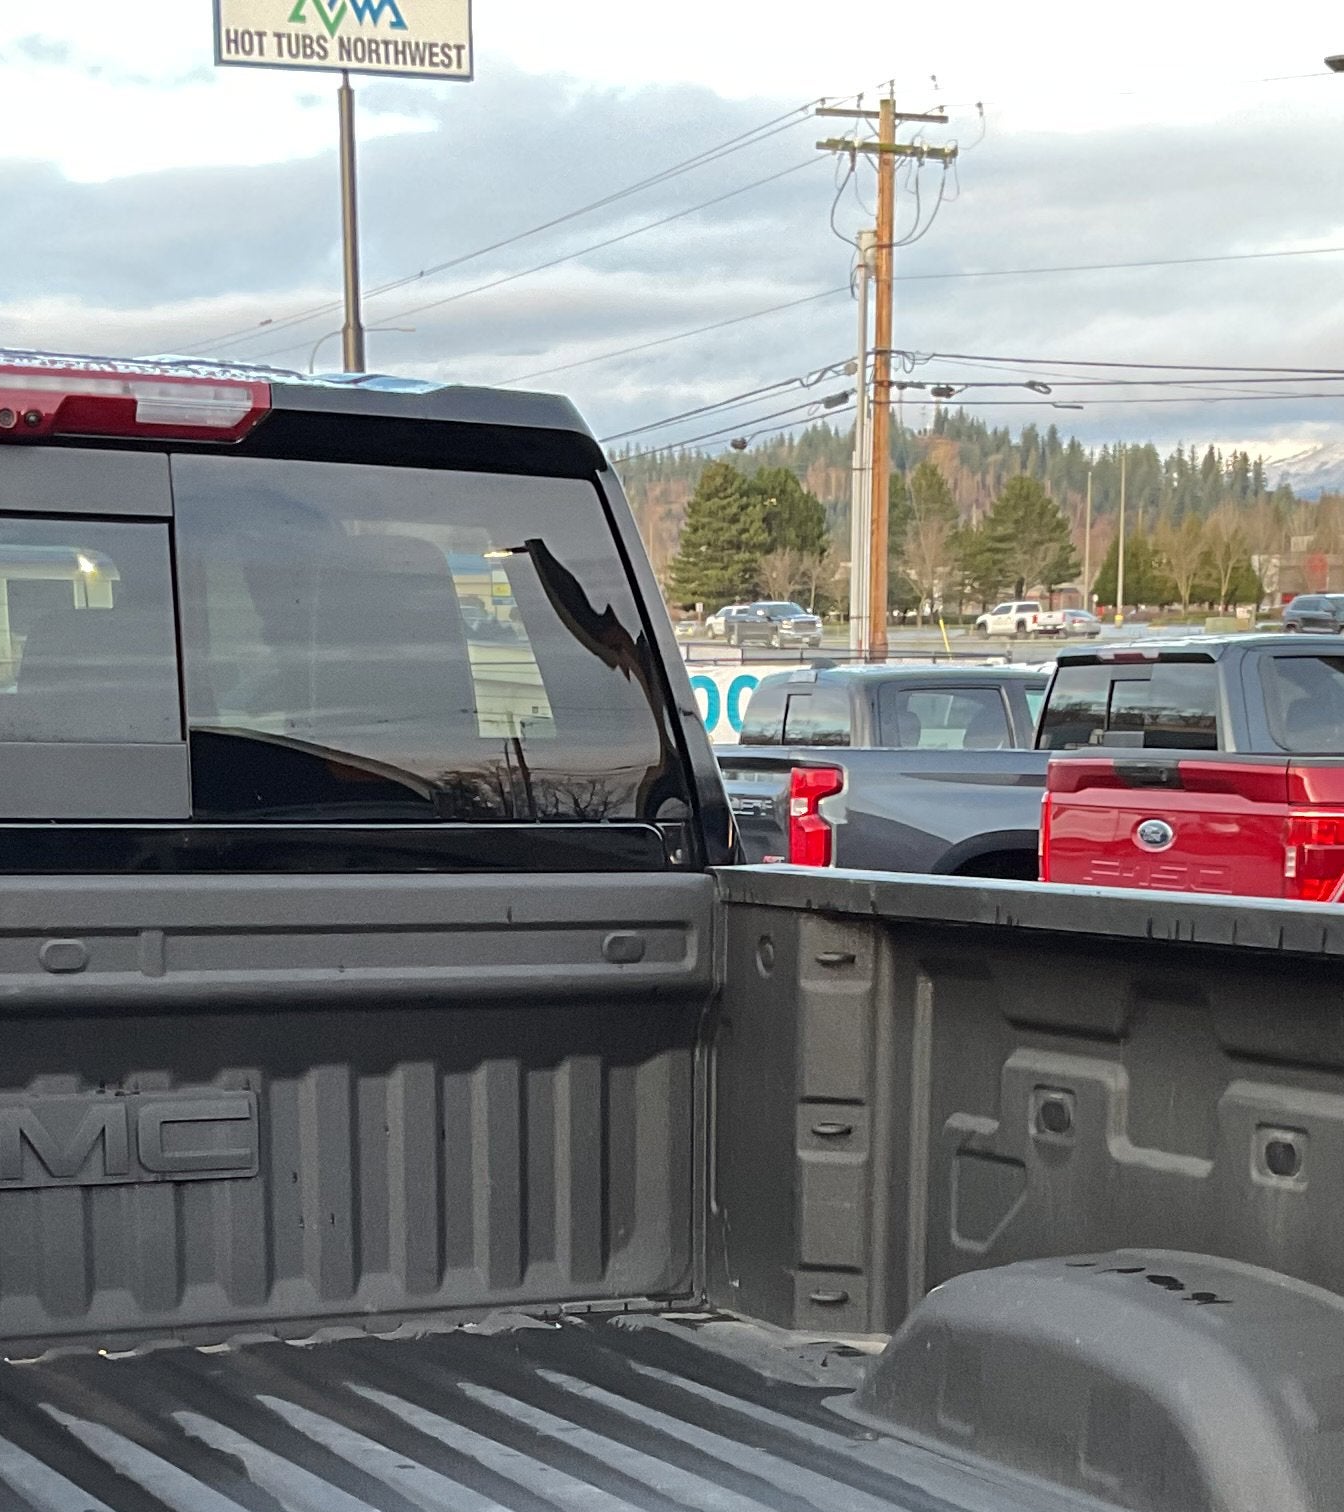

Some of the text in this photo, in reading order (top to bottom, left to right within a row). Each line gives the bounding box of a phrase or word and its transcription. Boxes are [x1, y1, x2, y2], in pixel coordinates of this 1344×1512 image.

[223, 28, 466, 70] HOT TUBS NORTHWEST
